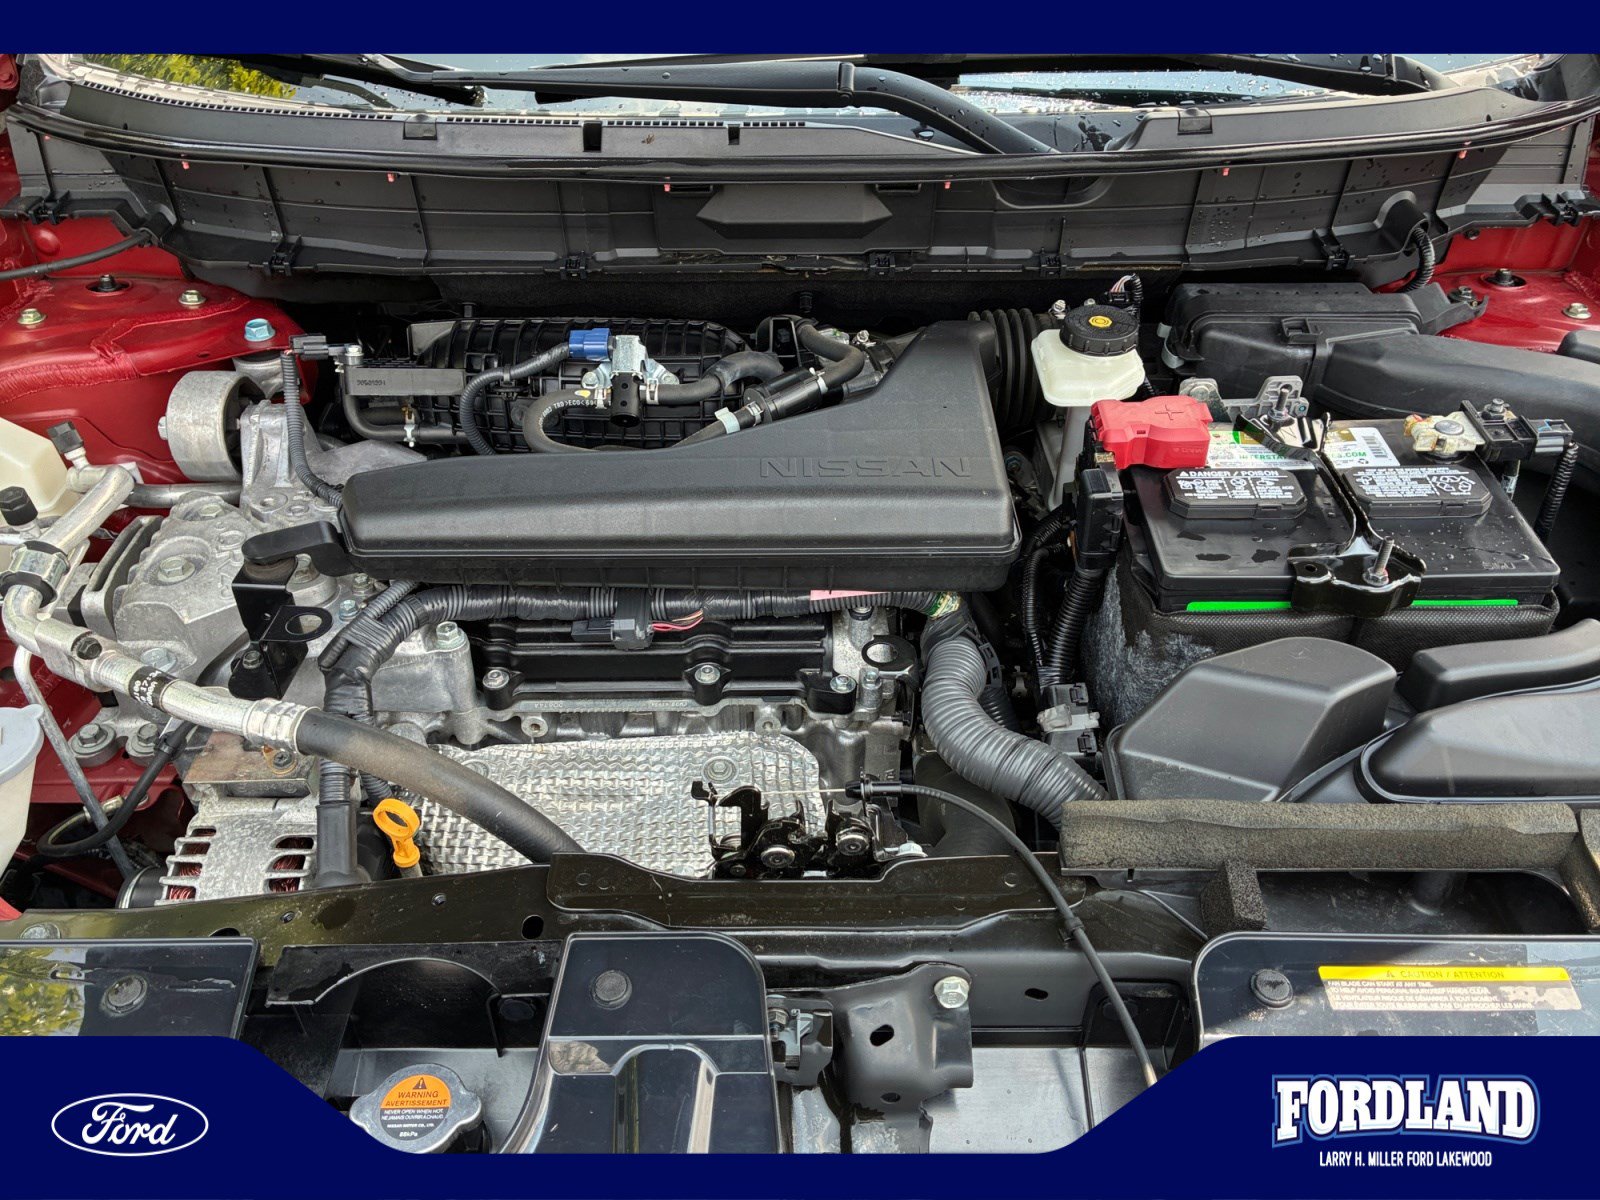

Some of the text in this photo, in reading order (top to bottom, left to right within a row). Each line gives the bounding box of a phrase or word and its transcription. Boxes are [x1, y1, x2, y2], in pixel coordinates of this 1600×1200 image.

[759, 456, 971, 478] NISSAN
[1400, 970, 1443, 978] CAUTION
[1453, 970, 1505, 978] ATTENTION
[398, 1090, 439, 1099] WARNING
[385, 1099, 448, 1107] AVERTISSEMENT
